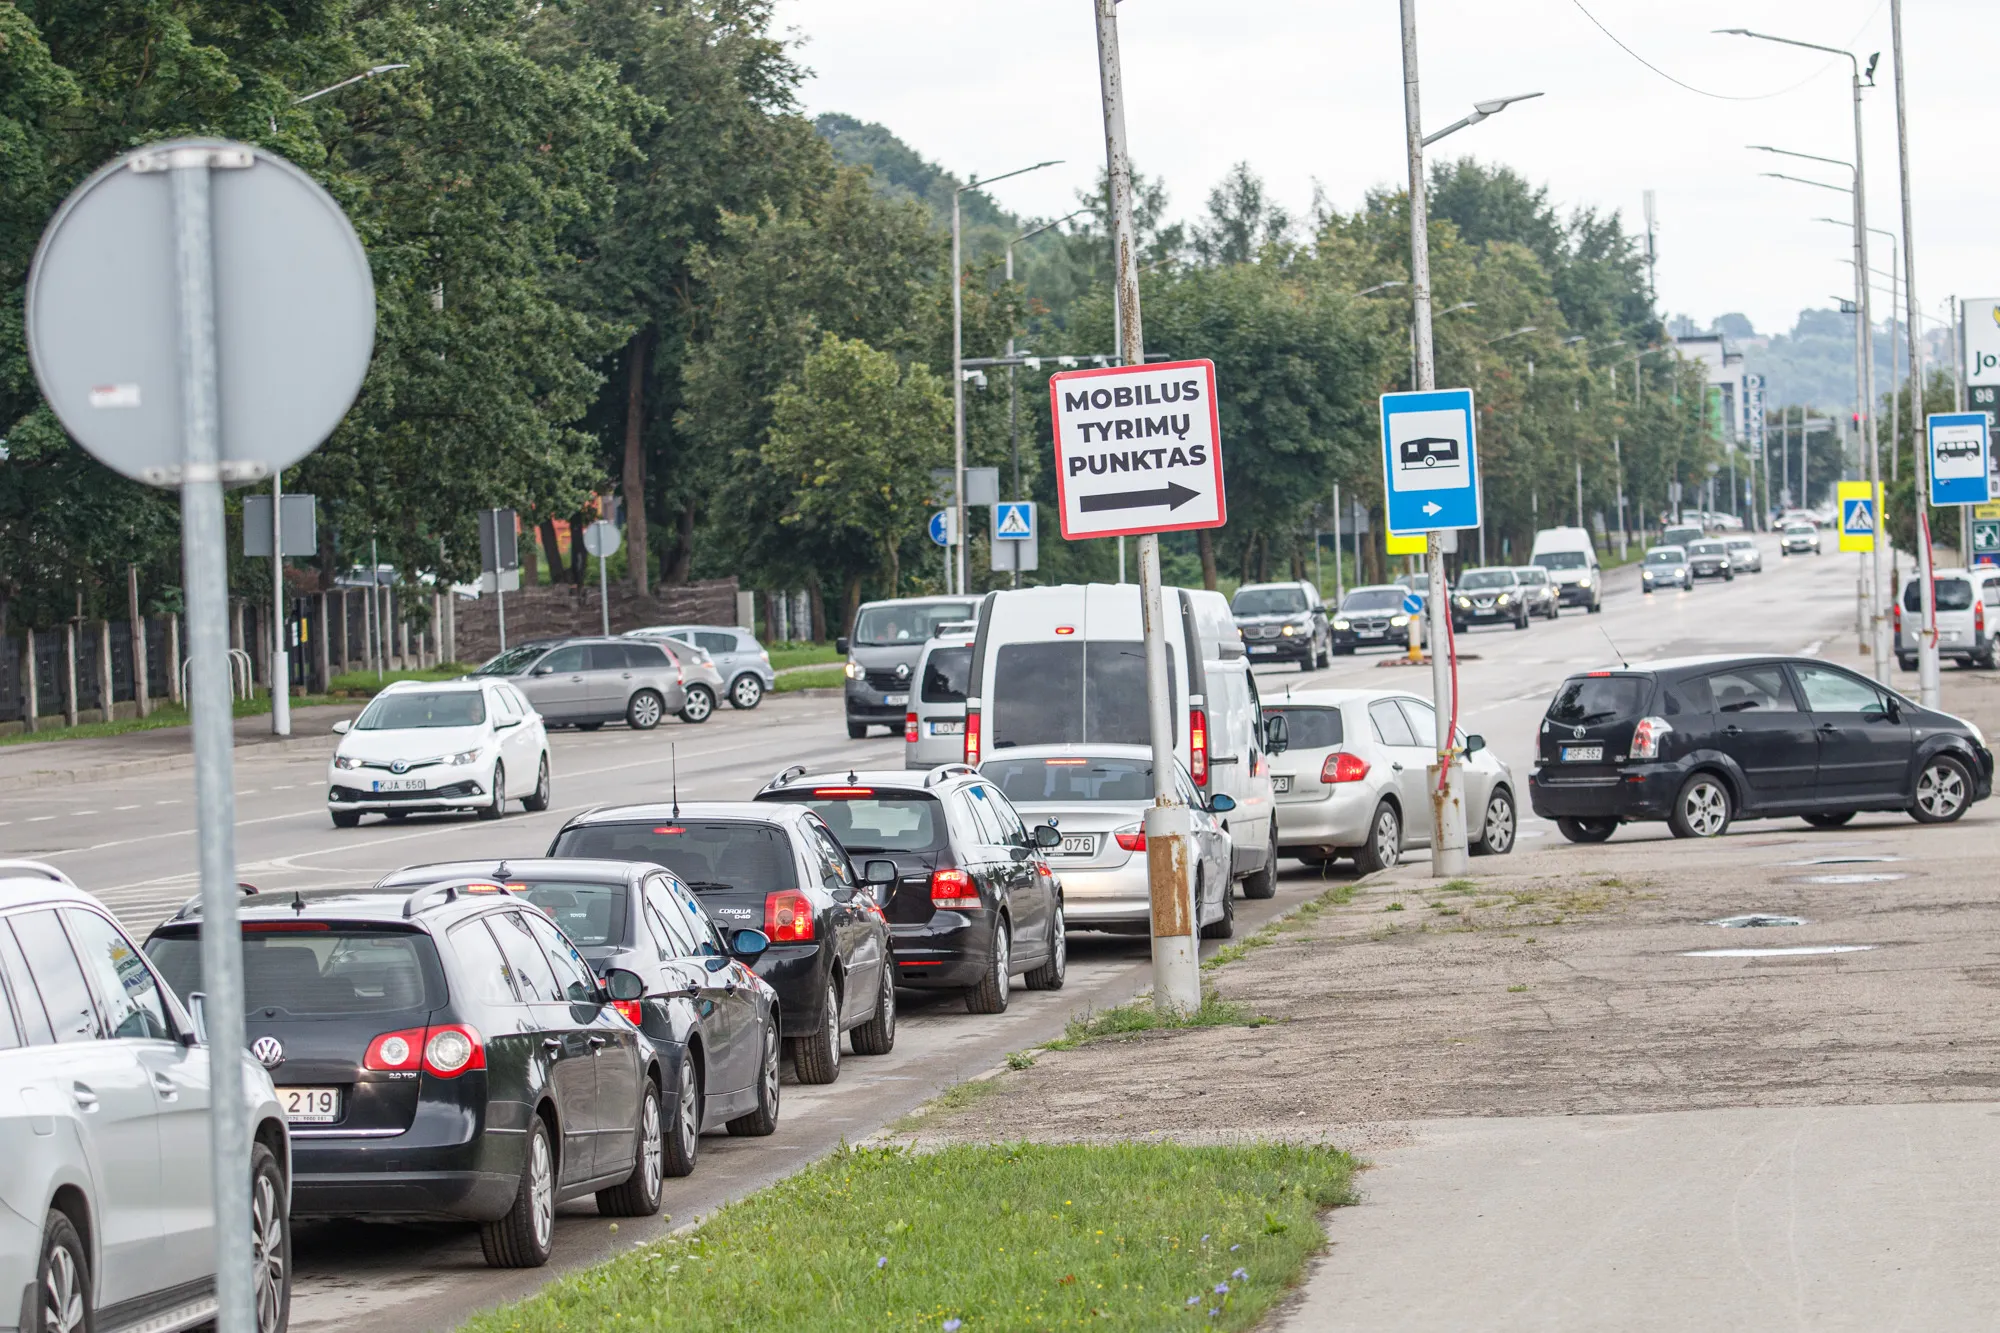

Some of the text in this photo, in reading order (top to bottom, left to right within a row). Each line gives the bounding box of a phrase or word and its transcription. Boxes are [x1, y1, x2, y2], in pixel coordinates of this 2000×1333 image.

[1974, 351, 2000, 376] Jo
[1065, 380, 1200, 412] MOBILUS
[1975, 387, 1995, 403] 98
[1077, 413, 1190, 441] TYRIMŲ
[1069, 445, 1207, 477] PUNKTAS
[380, 780, 423, 790] KJA 650
[1064, 838, 1091, 852] 076
[288, 1092, 333, 1113] 219
